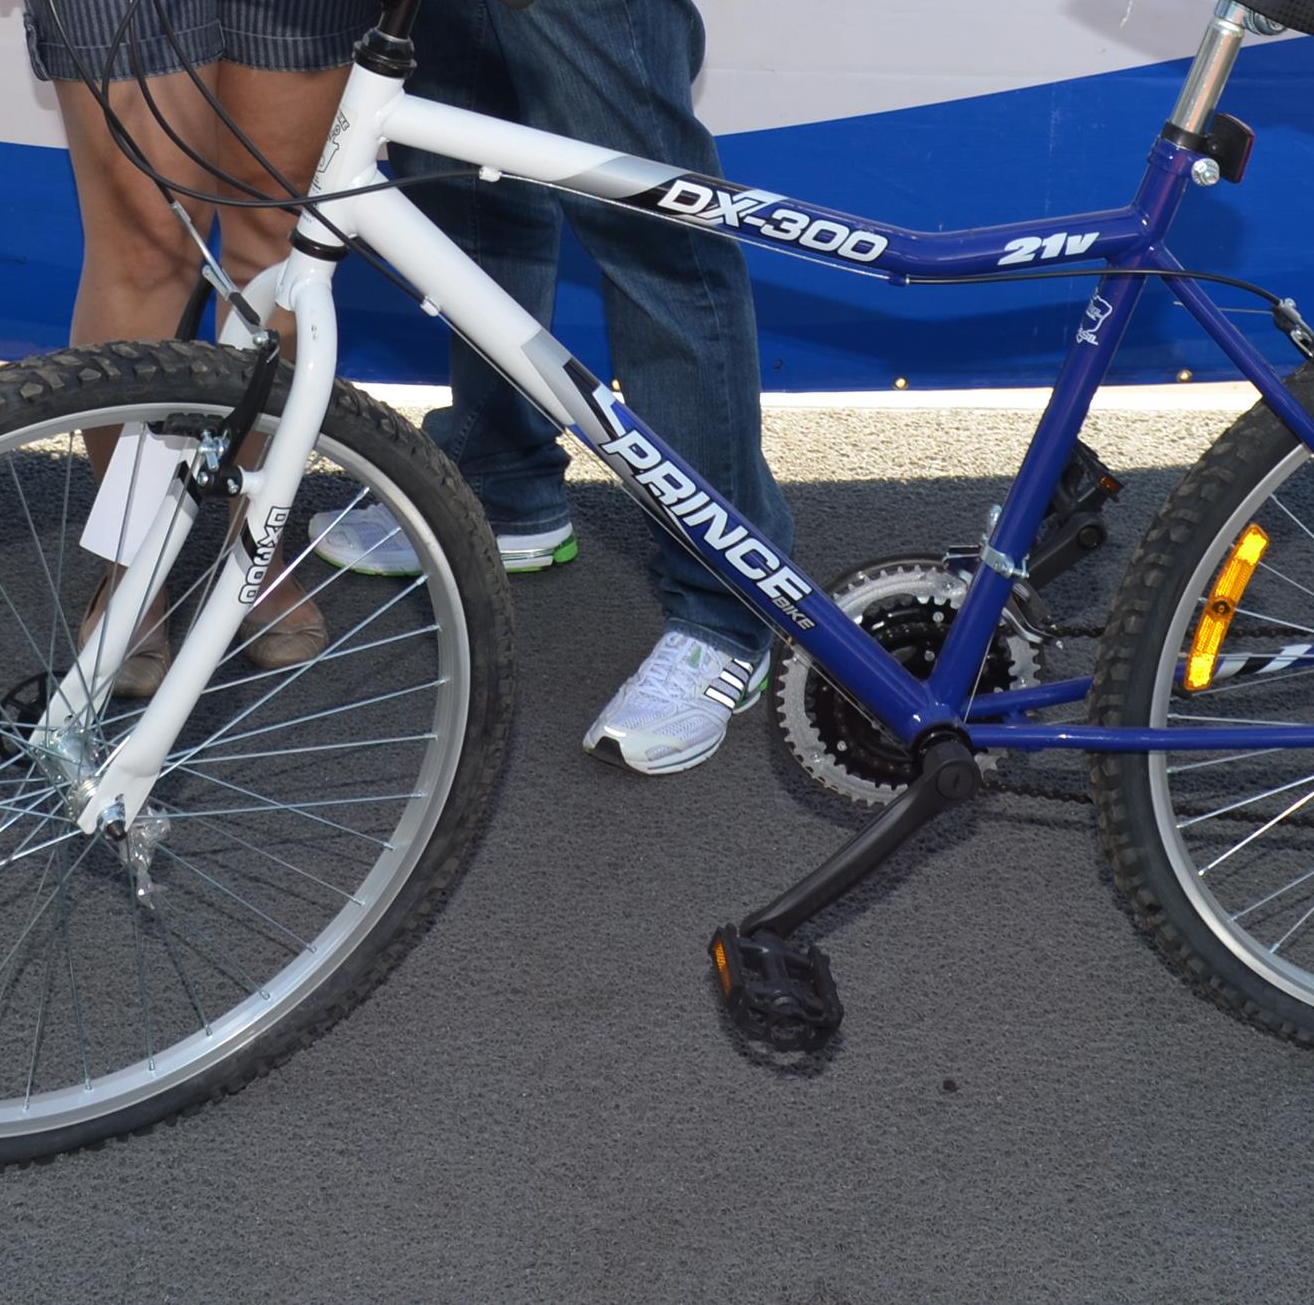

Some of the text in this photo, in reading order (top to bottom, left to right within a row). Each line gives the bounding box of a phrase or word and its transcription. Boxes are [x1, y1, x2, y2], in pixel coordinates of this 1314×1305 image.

[657, 180, 888, 262] DX-300
[600, 429, 814, 603] PRINCE
[771, 594, 816, 631] BIKE
